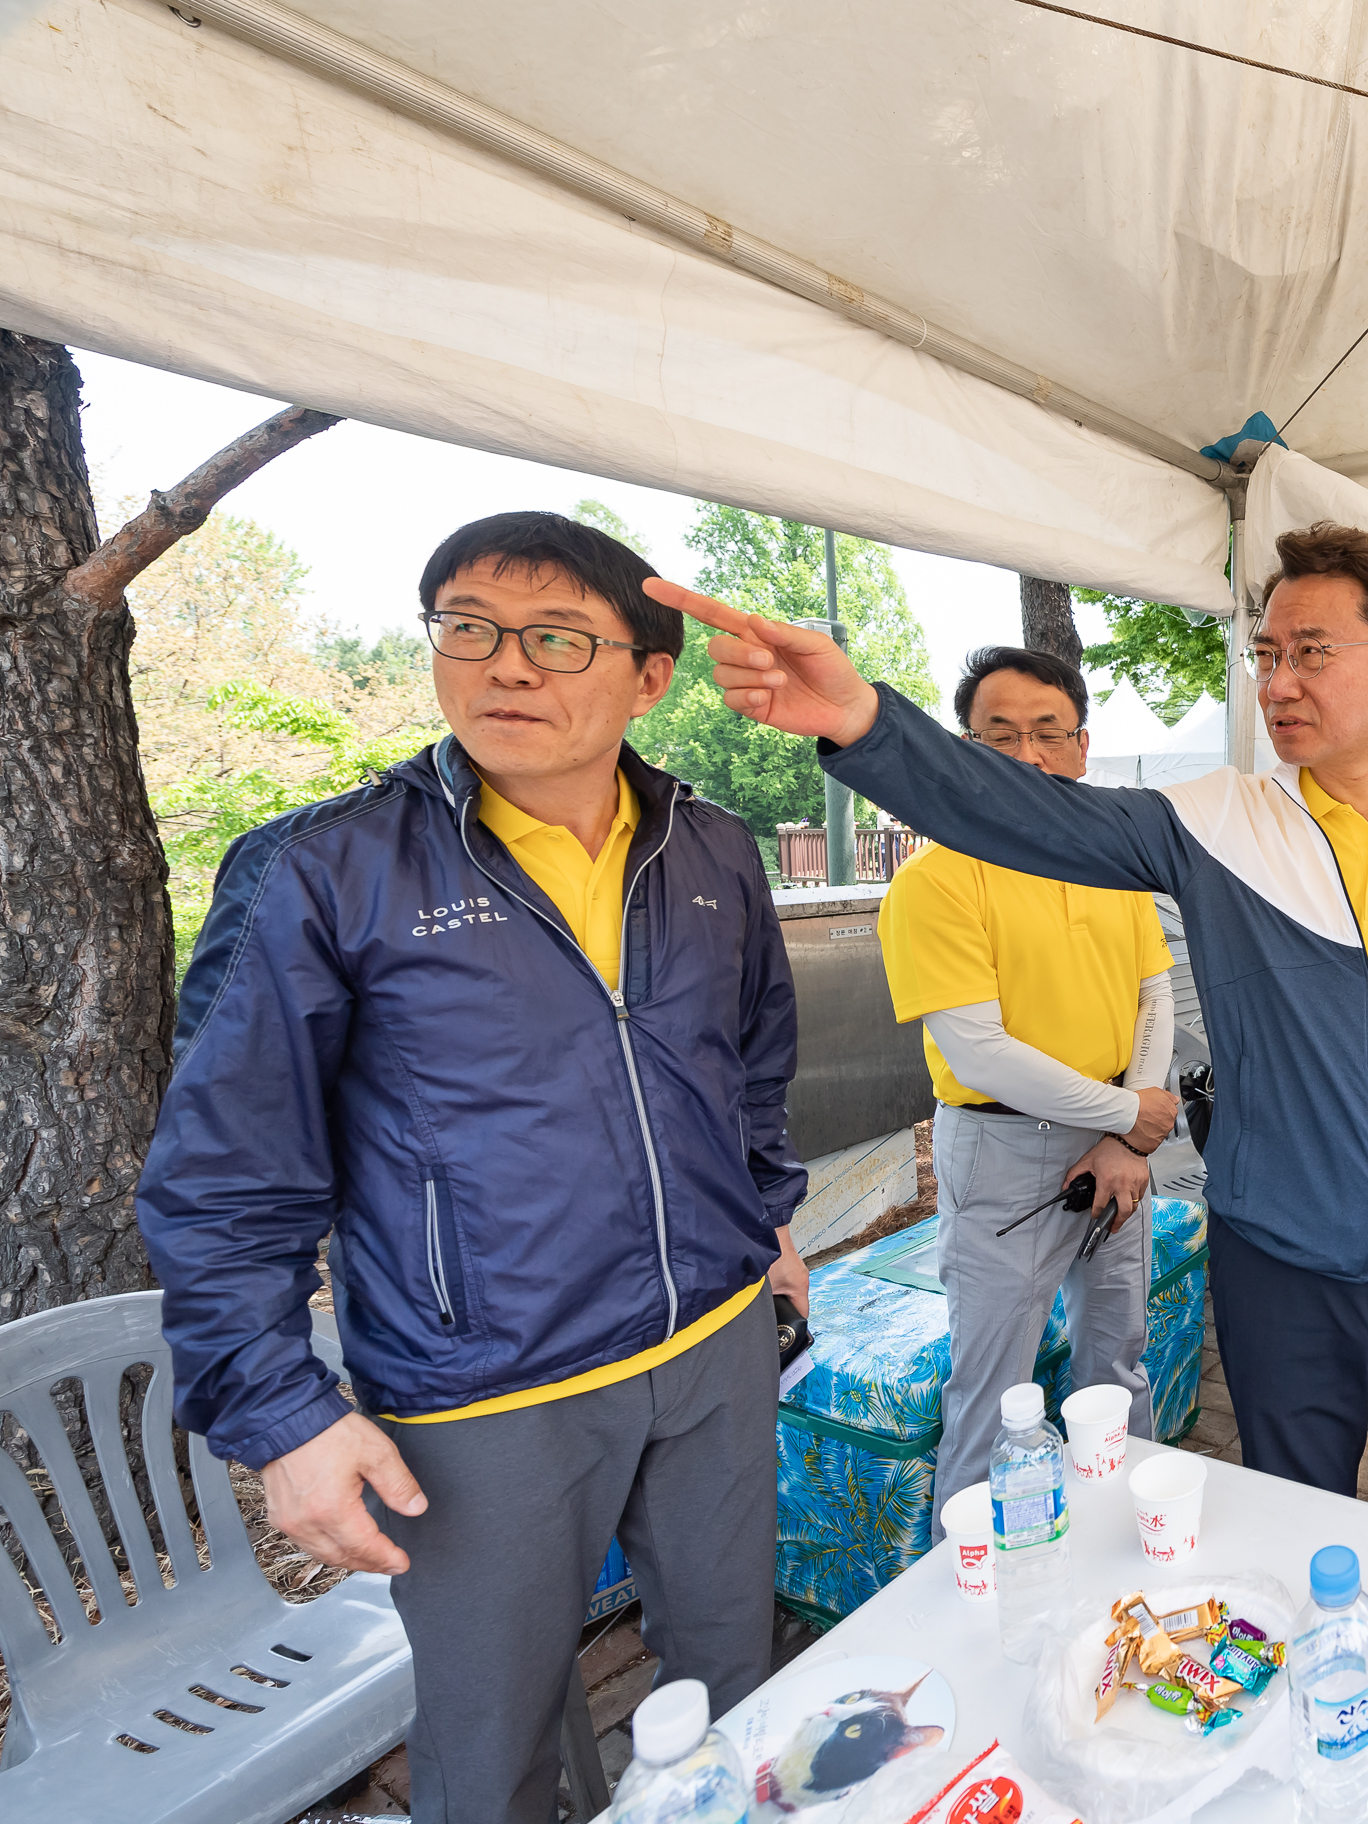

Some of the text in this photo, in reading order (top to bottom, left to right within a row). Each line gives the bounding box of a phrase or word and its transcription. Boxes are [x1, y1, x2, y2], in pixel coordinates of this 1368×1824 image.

[418, 897, 490, 920] LOUIS
[411, 911, 508, 938] CASTEL
[962, 1548, 986, 1558] Alpha
[1100, 1638, 1123, 1698] TWIX
[1178, 1657, 1222, 1697] TWIX
